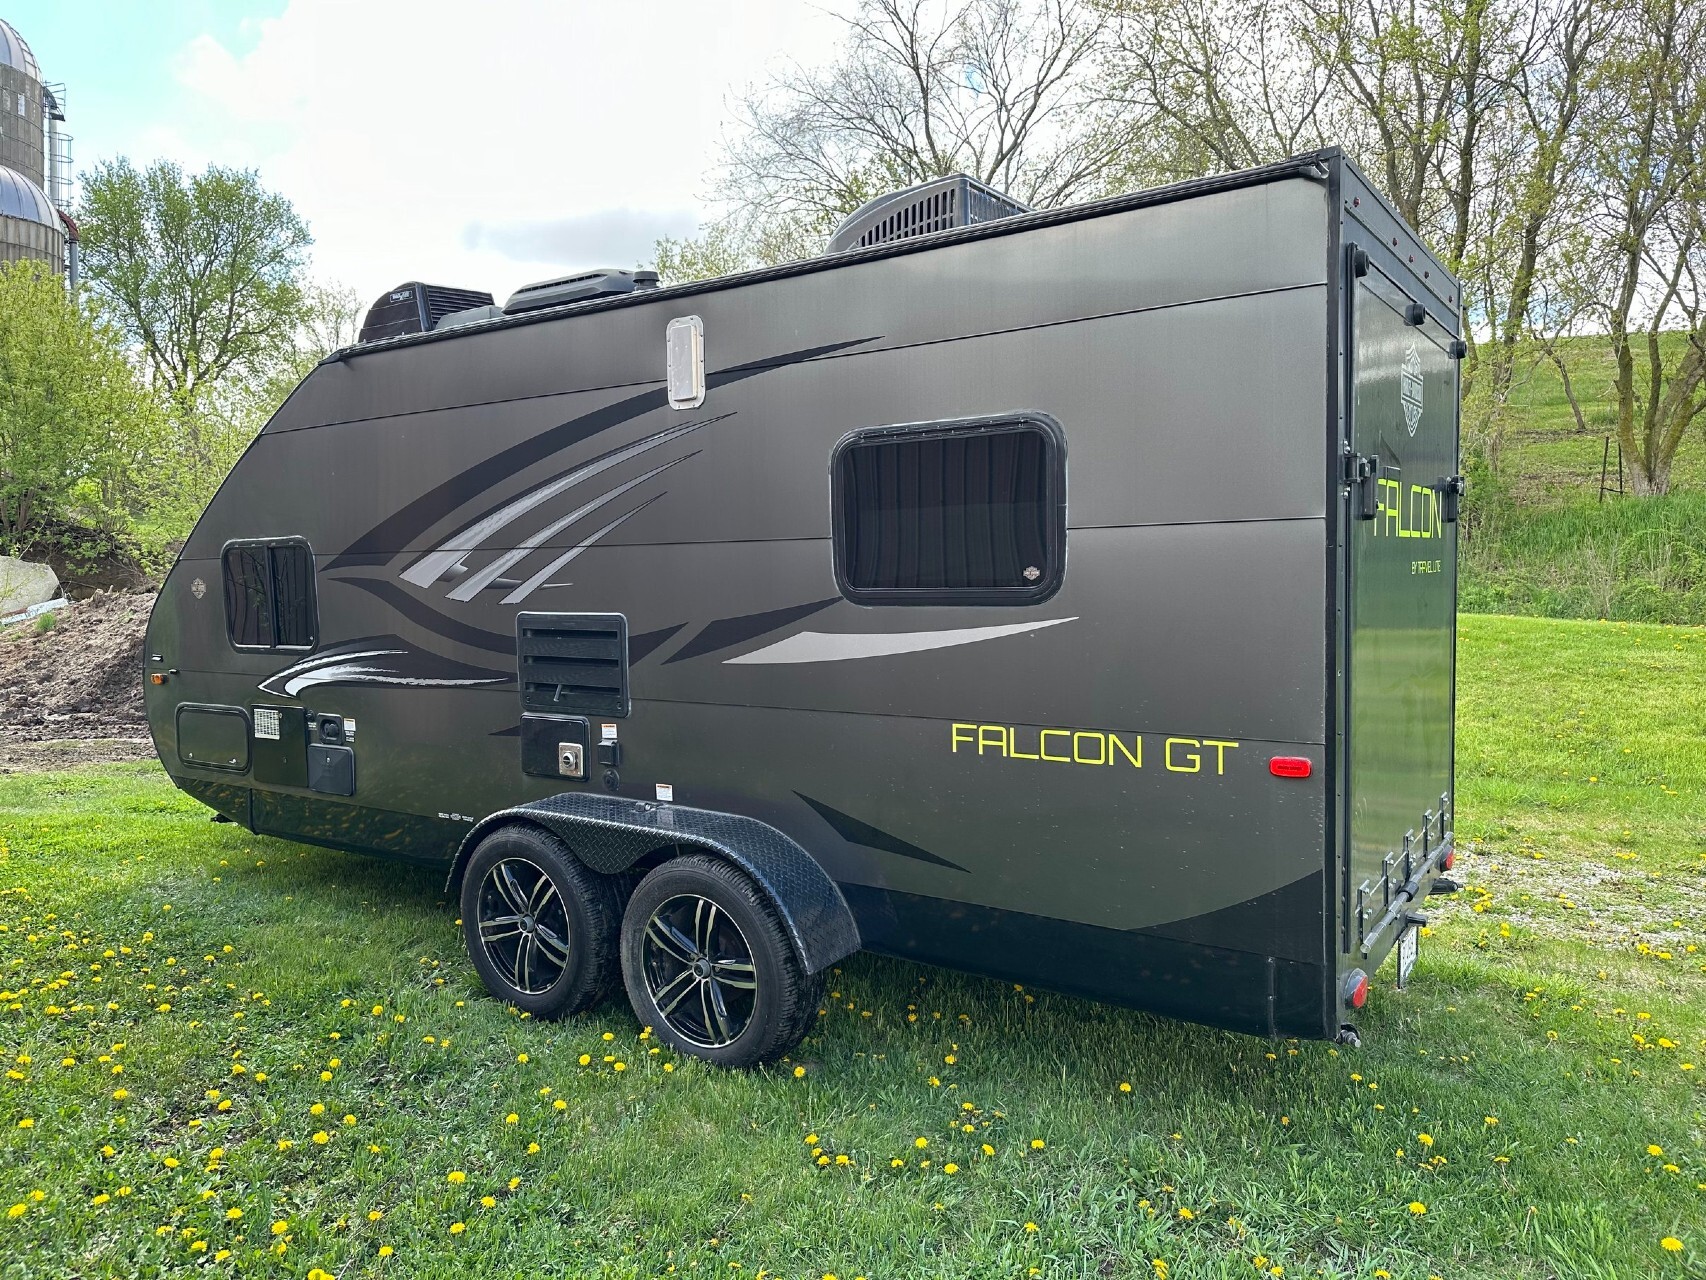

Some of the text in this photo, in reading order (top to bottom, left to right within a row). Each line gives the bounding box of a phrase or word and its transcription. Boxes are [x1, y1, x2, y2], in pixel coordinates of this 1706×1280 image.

[1374, 478, 1442, 539] FALCON
[951, 722, 1240, 775] FALCON GT
